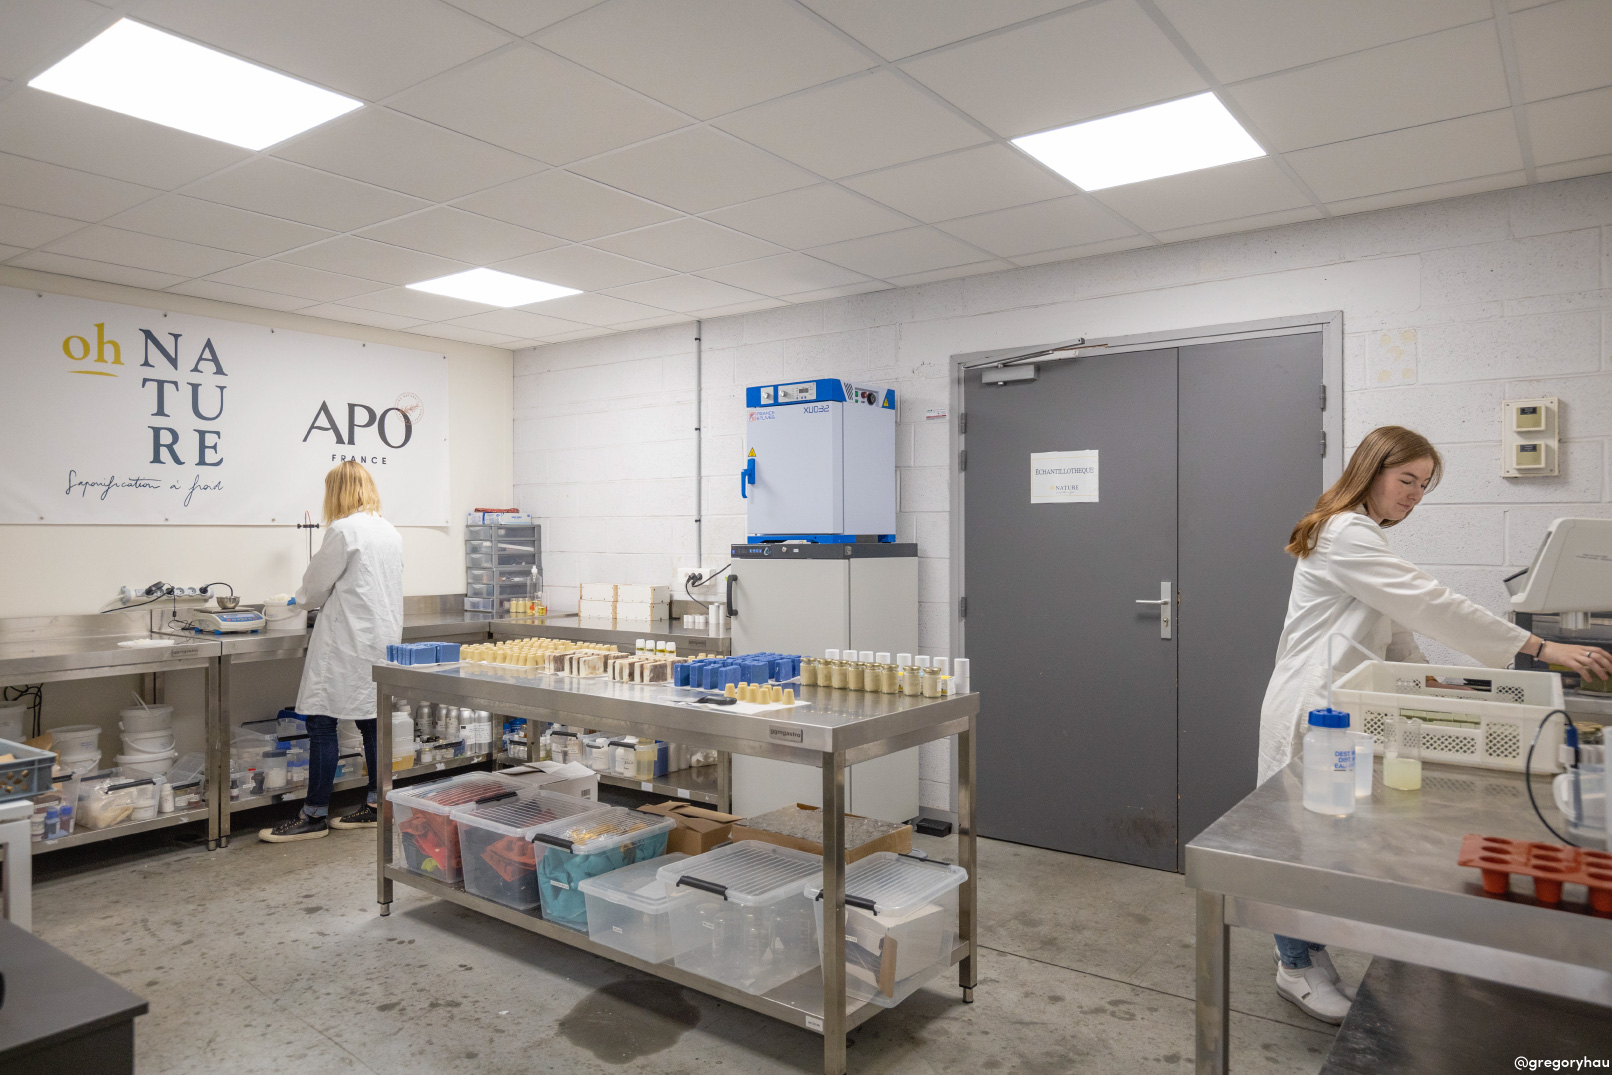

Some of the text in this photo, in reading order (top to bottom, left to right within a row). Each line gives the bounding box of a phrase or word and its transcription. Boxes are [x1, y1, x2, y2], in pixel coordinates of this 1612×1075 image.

[62, 322, 124, 365] oh
[302, 400, 413, 450] APO
[331, 454, 387, 465] FRANCE
[65, 469, 162, 501] Saponification
